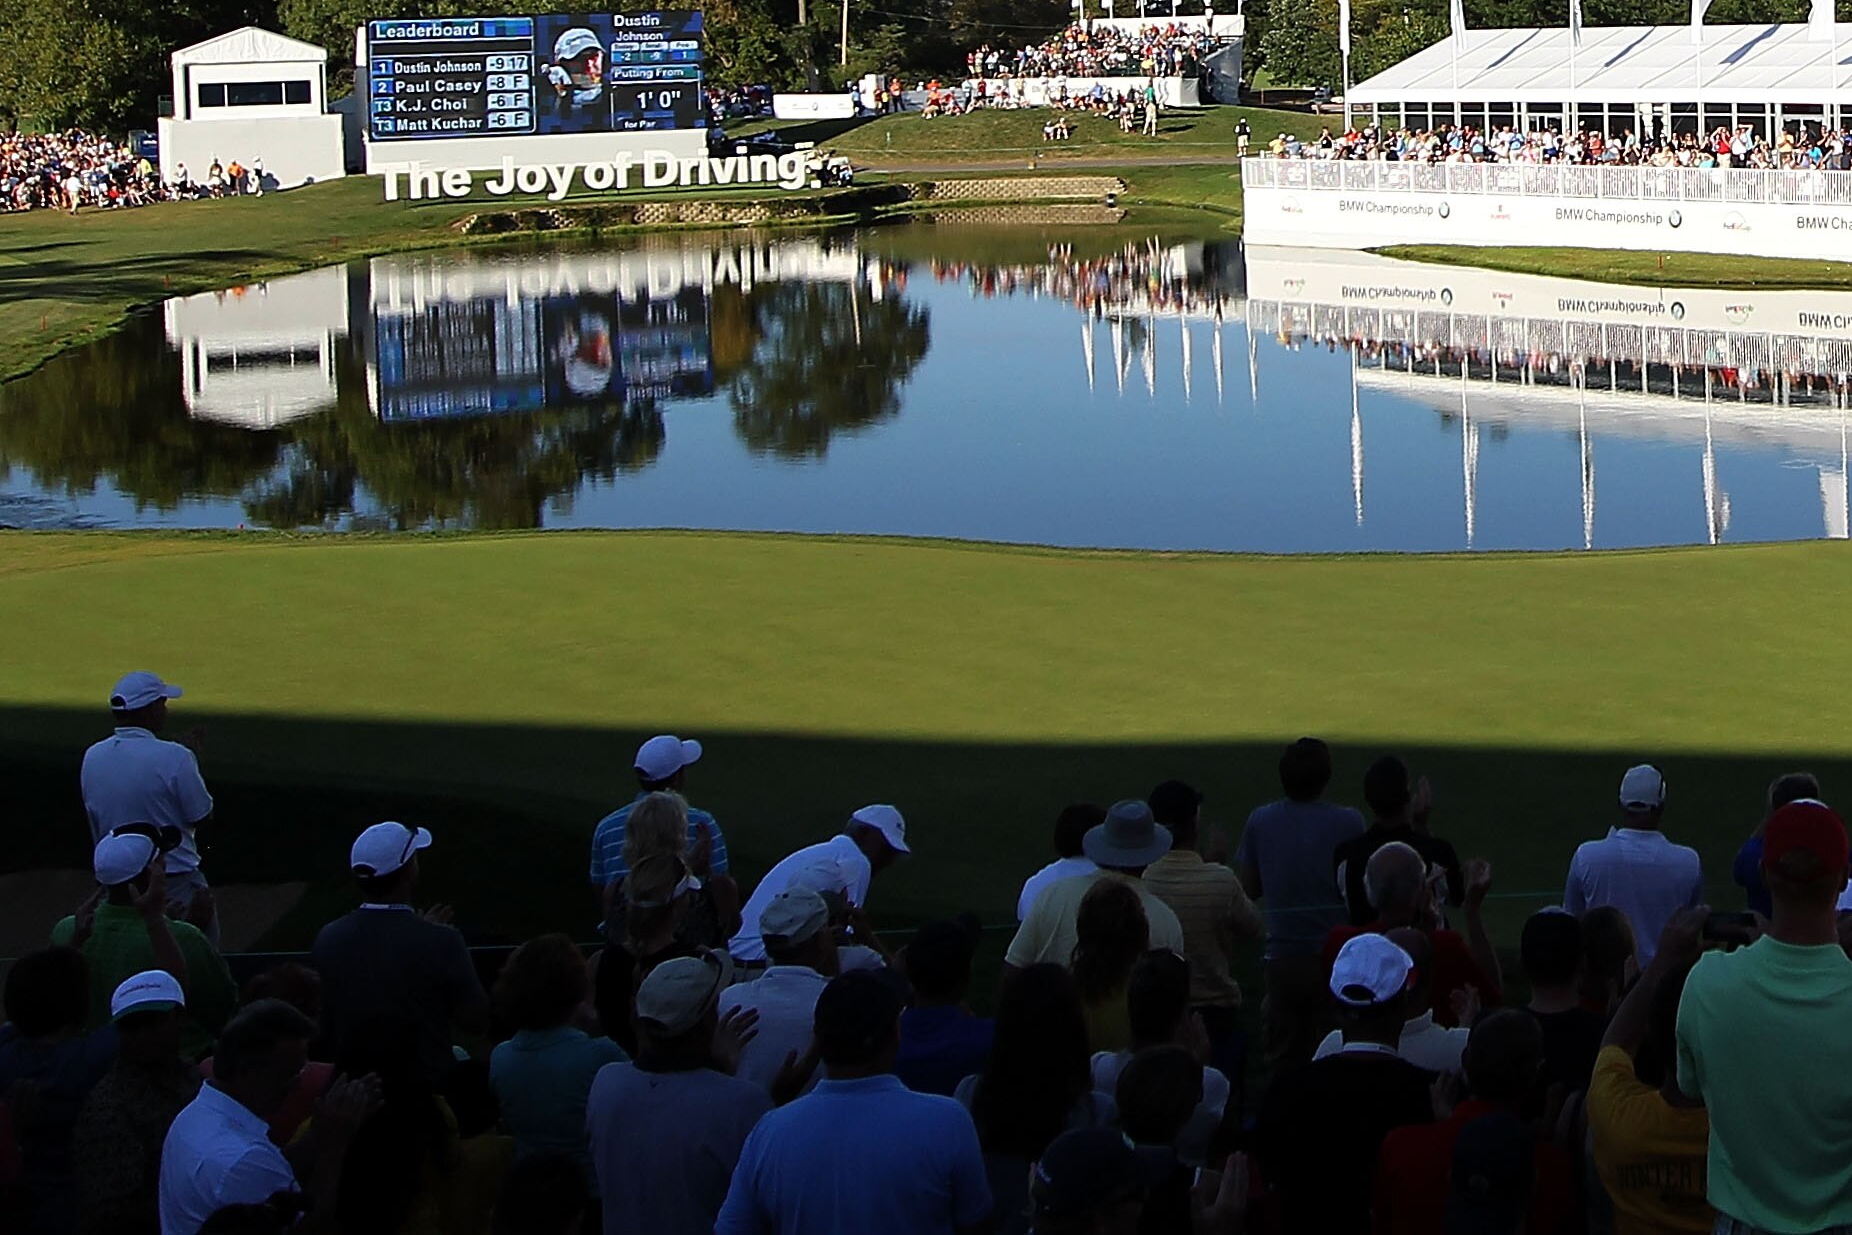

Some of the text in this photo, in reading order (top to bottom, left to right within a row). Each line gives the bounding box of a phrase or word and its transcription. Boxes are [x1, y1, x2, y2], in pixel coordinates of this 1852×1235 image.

[614, 14, 660, 27] Dustin
[376, 22, 479, 38] Leaderboard
[616, 31, 664, 41] Johnson
[621, 53, 631, 61] -2
[378, 57, 525, 74] 1 Dustin Johnson -9 17
[614, 69, 684, 79] Putting From
[378, 76, 522, 93] 2 Paul Casey -8 F
[375, 95, 523, 112] T3 K.J. Choi -6 F
[637, 91, 653, 109] 1'
[375, 113, 523, 132] T3 Matt Kuchar -6 F
[639, 120, 656, 128] Par
[381, 161, 472, 201] The
[485, 156, 577, 201] Joy
[584, 150, 632, 190] of
[1339, 201, 1433, 216] BMW Championship
[1555, 208, 1663, 225] BMW Championship
[1796, 216, 1829, 229] BMW
